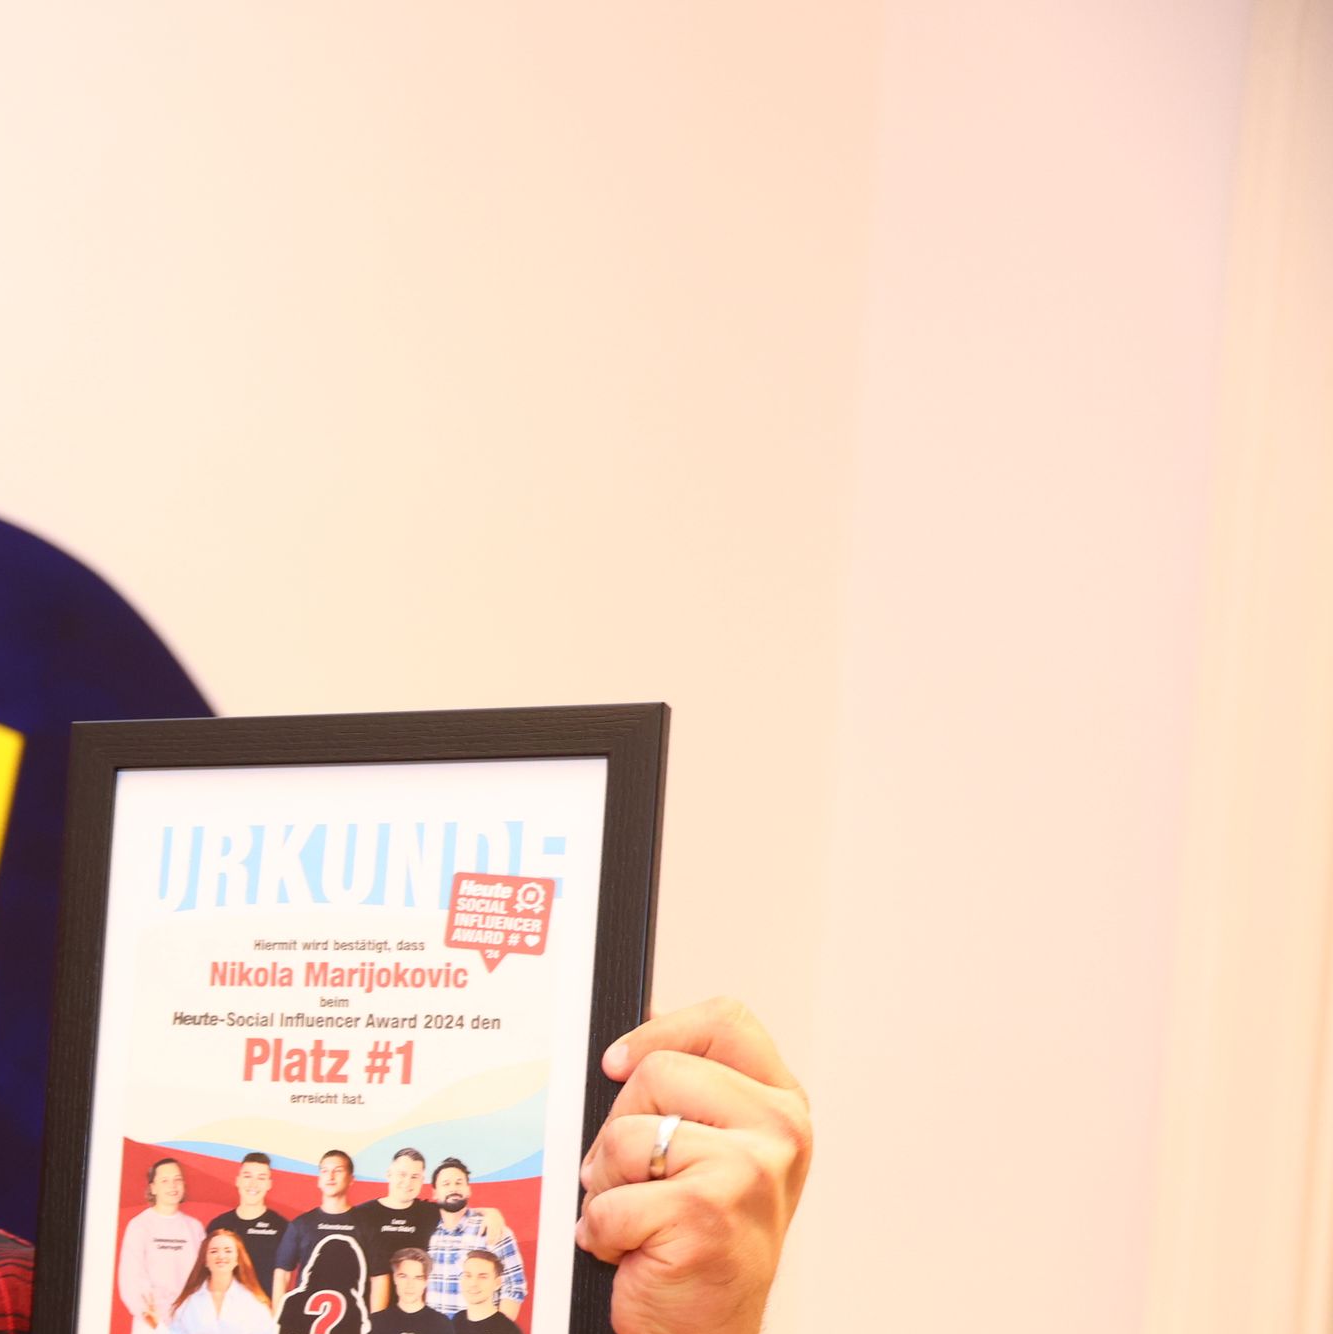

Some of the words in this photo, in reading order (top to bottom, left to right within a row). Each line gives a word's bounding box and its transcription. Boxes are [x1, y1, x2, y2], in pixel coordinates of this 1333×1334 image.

[151, 820, 569, 911] URKUNDE
[459, 880, 513, 899] Heute
[456, 897, 509, 914] SOCIAL
[454, 912, 542, 933] INFLUENCER
[451, 927, 505, 945] AWARD
[253, 939, 297, 951] Hiermit
[302, 940, 329, 951] wird
[333, 939, 391, 953] bestätigt,
[396, 940, 425, 951] dass
[209, 961, 294, 987] Nikola
[304, 961, 469, 994] Marijokovic
[319, 996, 349, 1008] beim
[172, 1011, 274, 1027] Heute-Social
[280, 1012, 360, 1028] Influencer
[365, 1013, 418, 1029] Award
[423, 1014, 465, 1029] 2024
[470, 1015, 501, 1030] den
[242, 1037, 351, 1084] Platz
[364, 1040, 415, 1085] #1
[289, 1092, 338, 1105] erreicht
[342, 1092, 366, 1105] hat.
